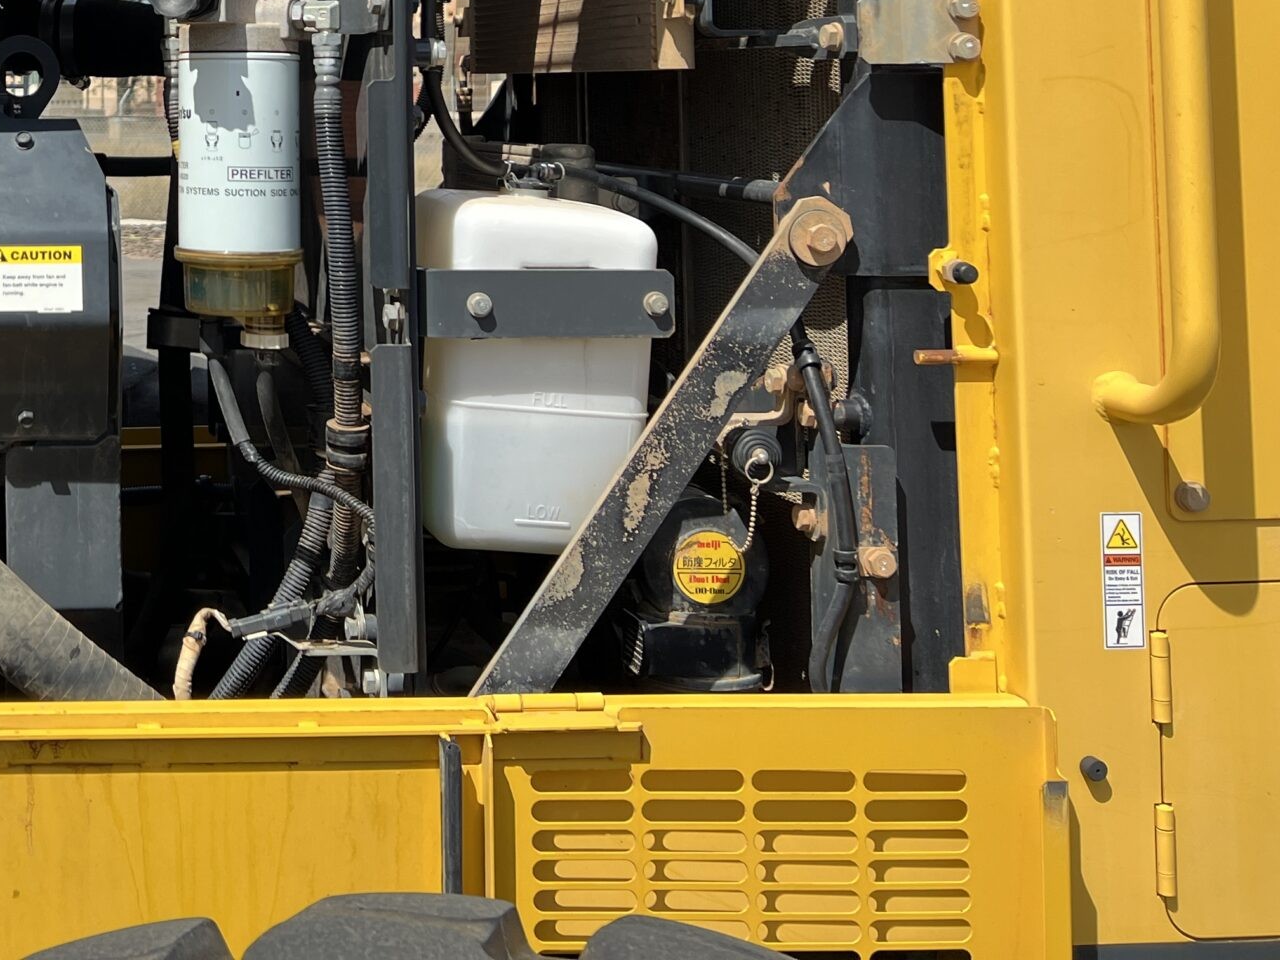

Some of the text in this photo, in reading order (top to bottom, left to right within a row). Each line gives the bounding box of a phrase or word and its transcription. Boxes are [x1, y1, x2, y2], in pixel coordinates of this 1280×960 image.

[231, 168, 292, 179] PREFILTER
[186, 186, 220, 196] SYSTEMS
[224, 188, 266, 197] SUCTION
[271, 188, 288, 197] SIDE
[10, 250, 72, 261] CAUTION
[531, 391, 568, 409] FULL
[527, 503, 561, 520] LOW
